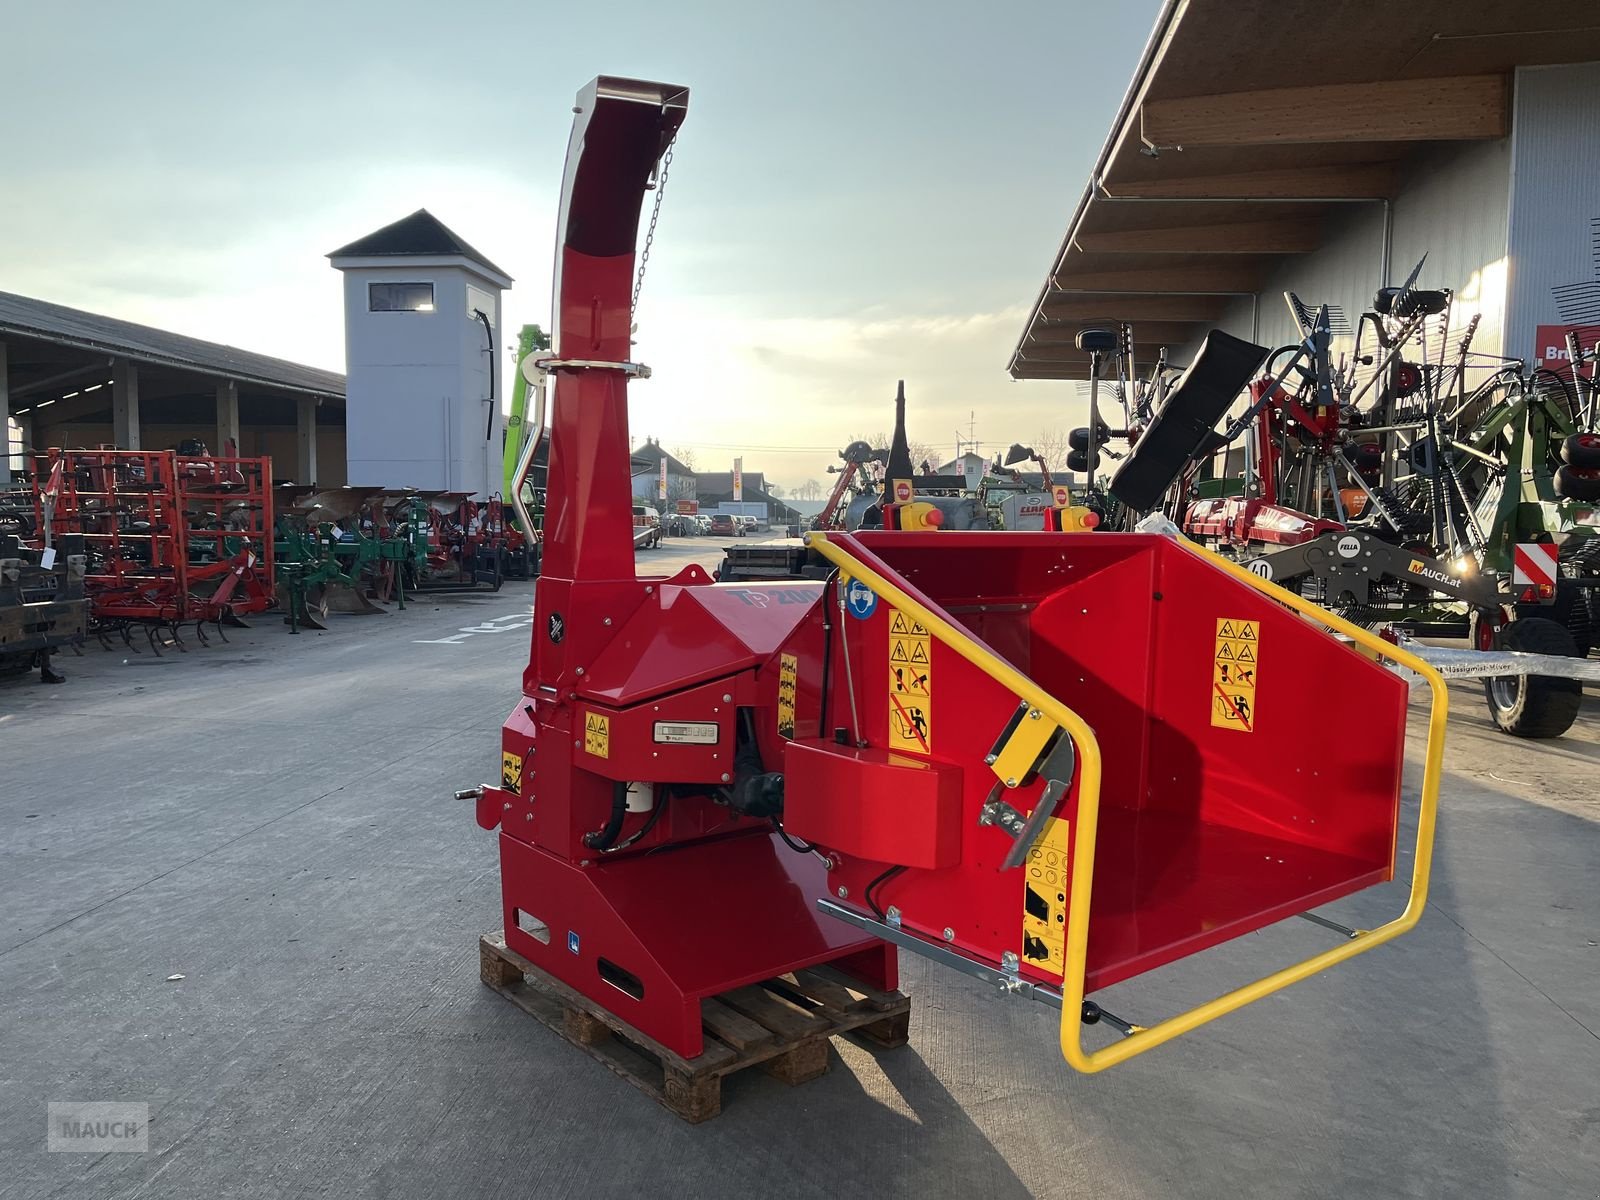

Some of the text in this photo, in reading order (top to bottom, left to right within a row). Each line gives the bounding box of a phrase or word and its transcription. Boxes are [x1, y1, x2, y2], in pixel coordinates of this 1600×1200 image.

[1252, 564, 1268, 579] 40
[1412, 564, 1462, 588] MAUCH.at
[725, 589, 819, 608] TP 200
